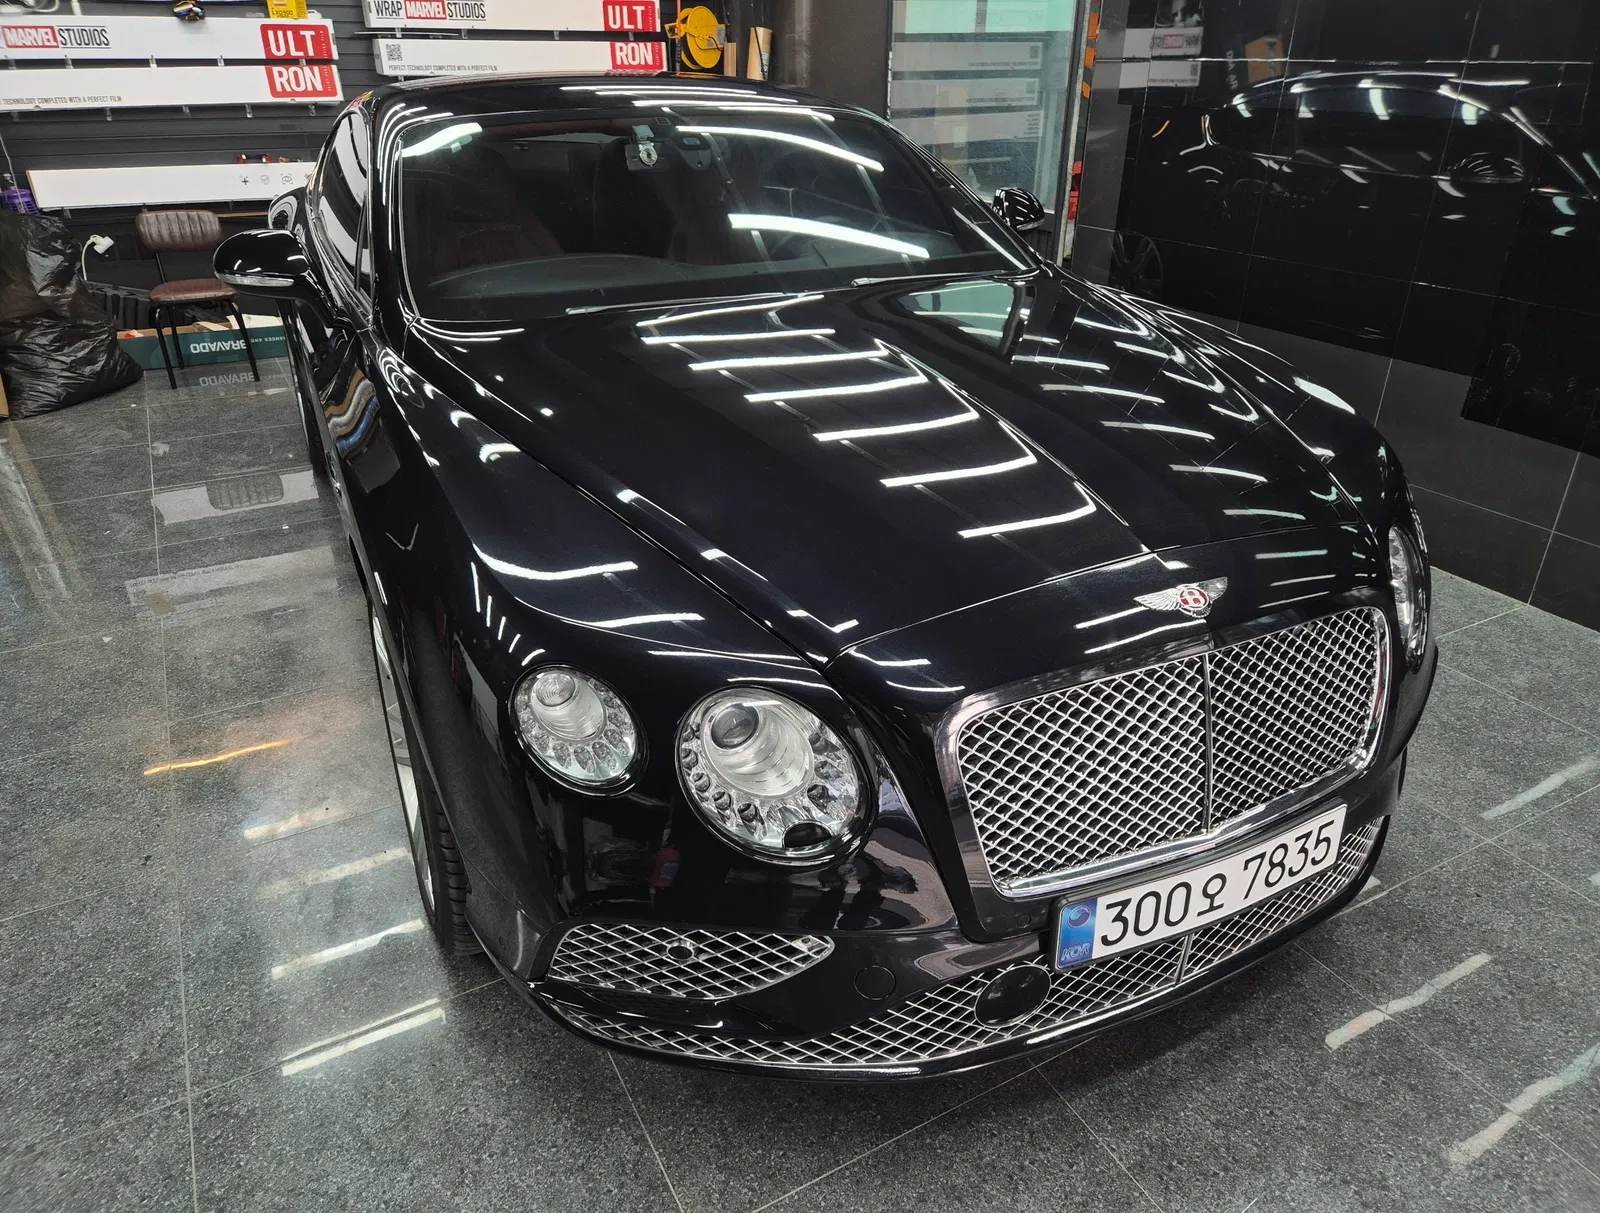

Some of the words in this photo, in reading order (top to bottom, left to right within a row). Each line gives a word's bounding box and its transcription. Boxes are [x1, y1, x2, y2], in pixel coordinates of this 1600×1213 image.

[375, 1, 403, 17] WRAP
[406, 1, 446, 18] MARVEL
[447, 2, 486, 19] STUDIOS
[607, 5, 645, 30] ULT
[3, 27, 58, 47] MARVEL
[57, 28, 110, 47] STUDIOS
[267, 30, 315, 57] ULT
[615, 42, 653, 66] RON
[271, 66, 324, 92] RON
[3, 97, 36, 105] TECHNOLOGY
[37, 96, 68, 104] COMPLETED
[68, 96, 82, 104] WITH
[88, 95, 109, 103] PERFECT
[109, 95, 122, 103] FILM
[189, 339, 247, 354] BRAVADO
[1100, 872, 1228, 947] 300오
[1242, 818, 1336, 901] 7835
[1060, 941, 1092, 962] KOR
